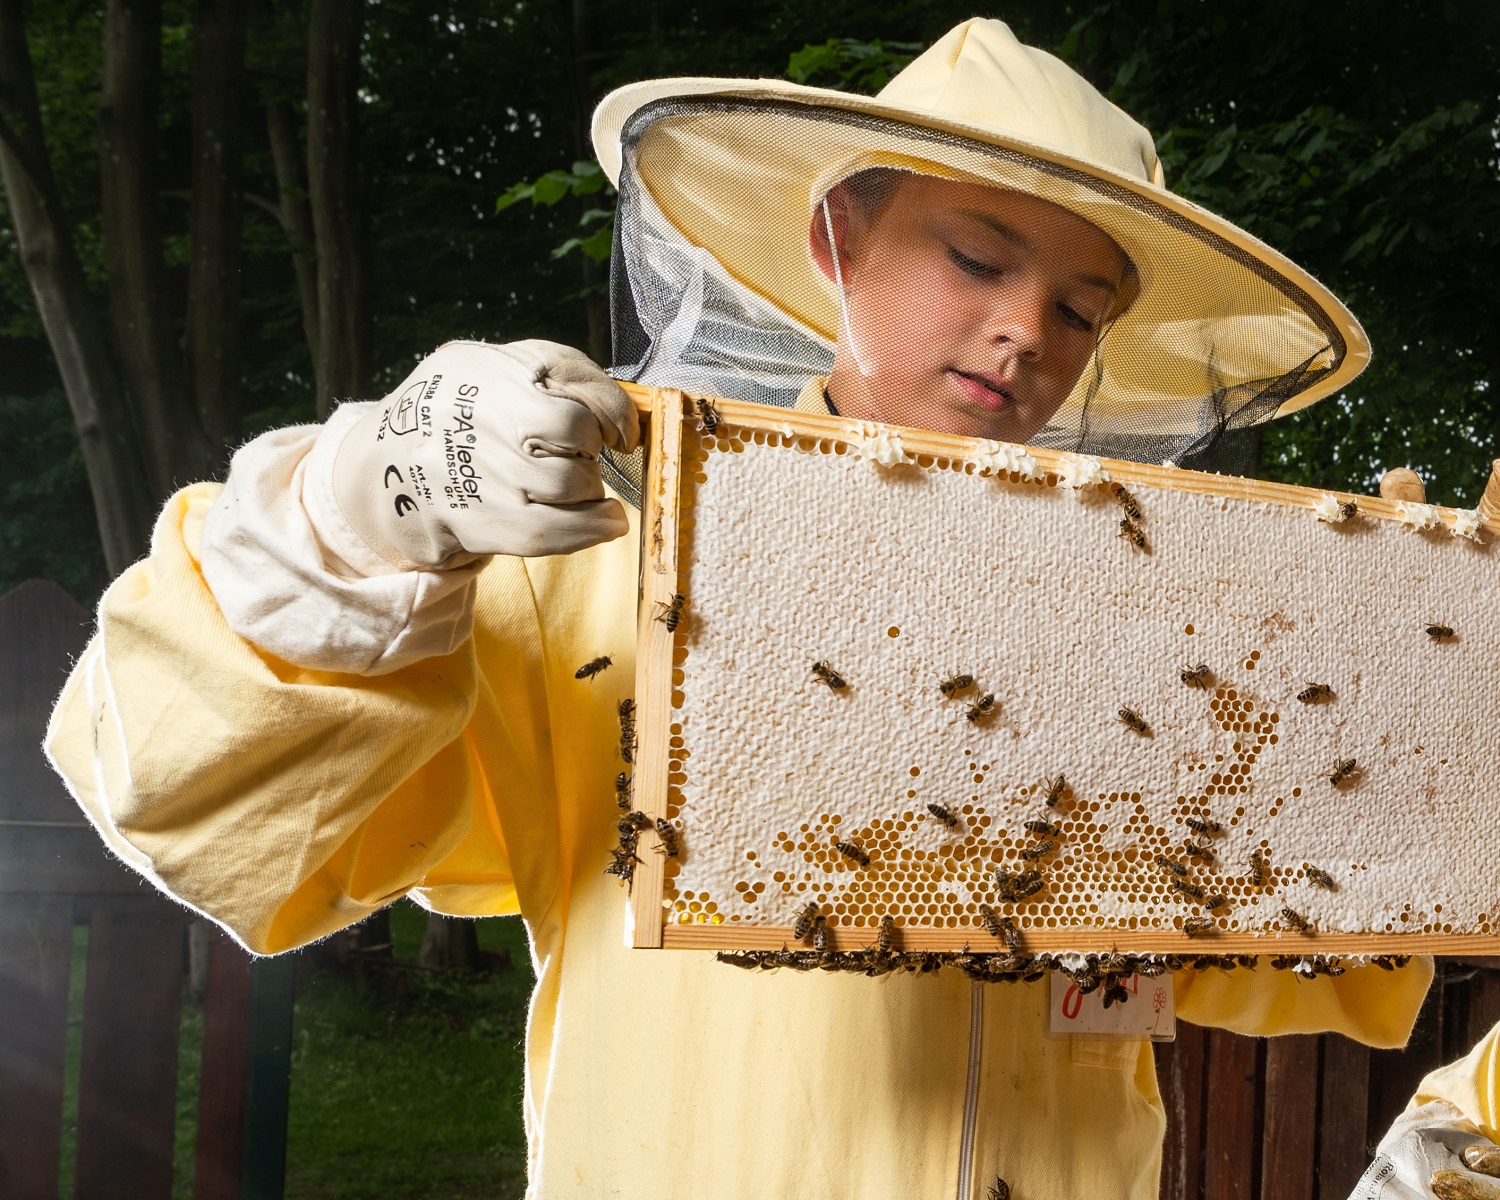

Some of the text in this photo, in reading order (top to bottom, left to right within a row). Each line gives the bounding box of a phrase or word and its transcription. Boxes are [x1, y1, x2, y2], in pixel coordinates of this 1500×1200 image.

[423, 374, 443, 400] EN388
[420, 406, 432, 427] CAT
[443, 428, 469, 510] HANDSCHUHE
[444, 486, 454, 500] Gr.
